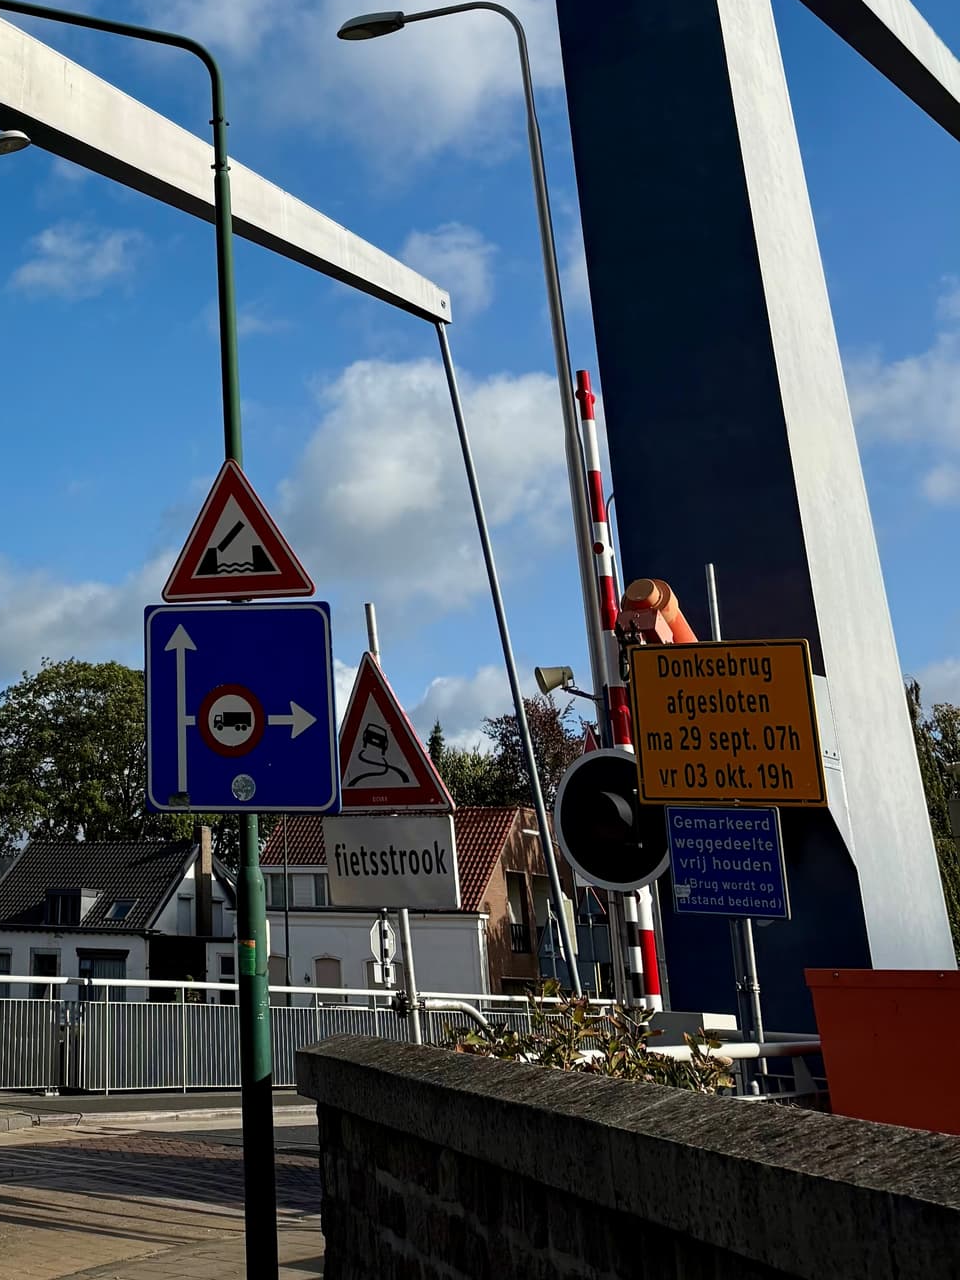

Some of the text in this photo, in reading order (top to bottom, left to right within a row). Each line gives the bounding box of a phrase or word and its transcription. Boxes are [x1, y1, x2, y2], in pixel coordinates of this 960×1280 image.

[657, 652, 773, 682] Donksebrug
[667, 689, 770, 720] afgesloten
[647, 725, 800, 757] ma 29 sept. 07h
[659, 763, 794, 789] vr 03 okt. 19h
[673, 815, 770, 831] Gemarkeerd
[674, 837, 774, 853] weggedeelte
[334, 840, 448, 877] fietsstrook
[680, 856, 772, 874] vrij houden
[722, 880, 756, 891] wordt
[759, 883, 774, 894] op
[728, 896, 782, 909] bediend)
